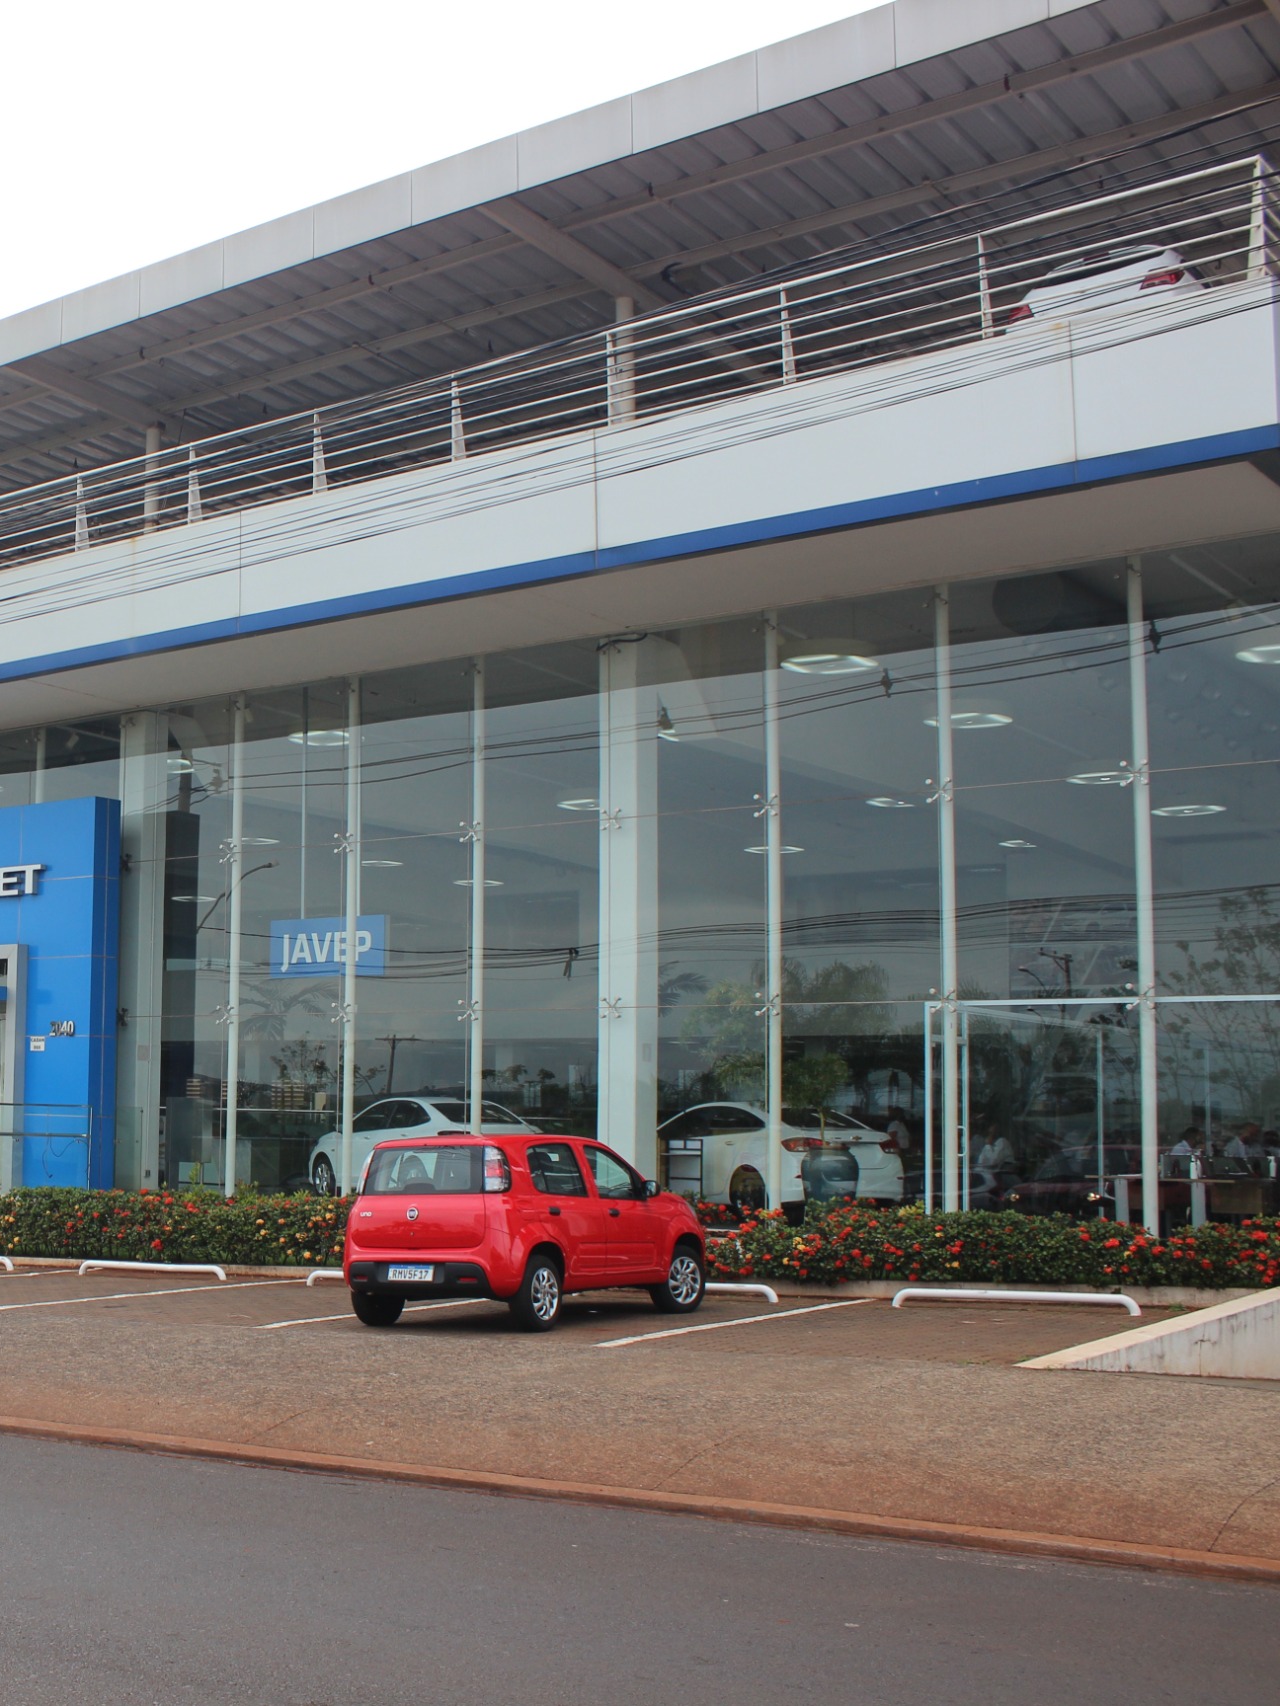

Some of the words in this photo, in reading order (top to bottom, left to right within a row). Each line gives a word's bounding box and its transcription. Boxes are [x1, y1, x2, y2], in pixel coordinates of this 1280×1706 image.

[281, 930, 372, 973] JAVEP
[49, 1020, 75, 1037] 2040
[392, 1269, 429, 1280] RMV5F17
